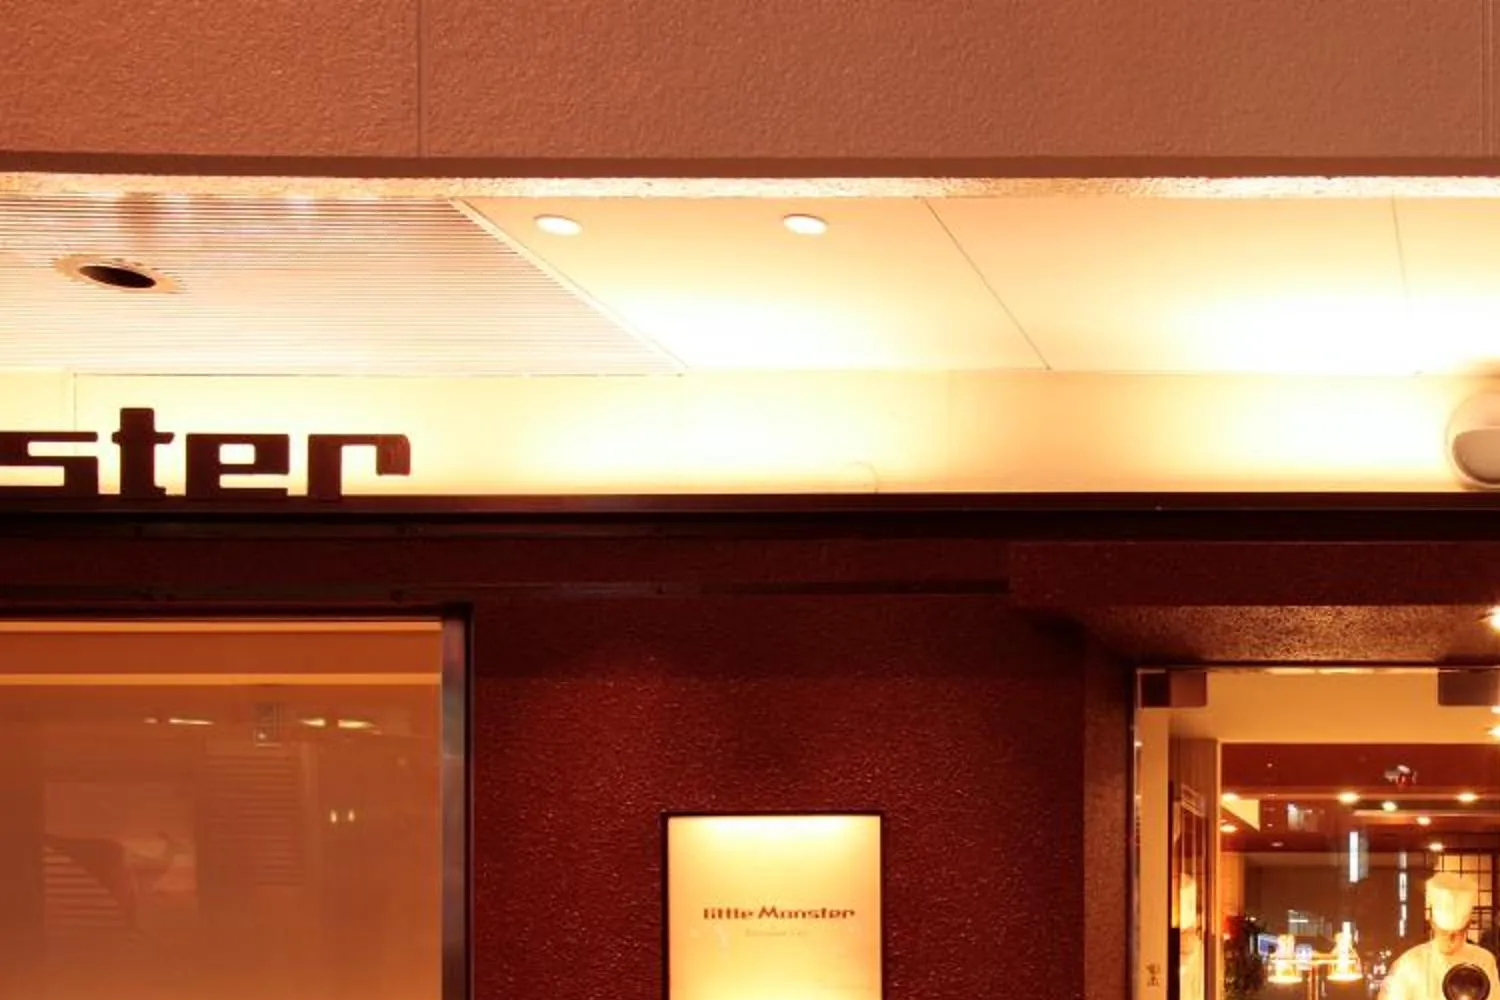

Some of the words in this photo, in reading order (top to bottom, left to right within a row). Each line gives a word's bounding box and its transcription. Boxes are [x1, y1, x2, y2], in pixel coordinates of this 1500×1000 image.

[0, 407, 411, 498] ster
[703, 907, 753, 920] little
[758, 905, 855, 920] Monster
